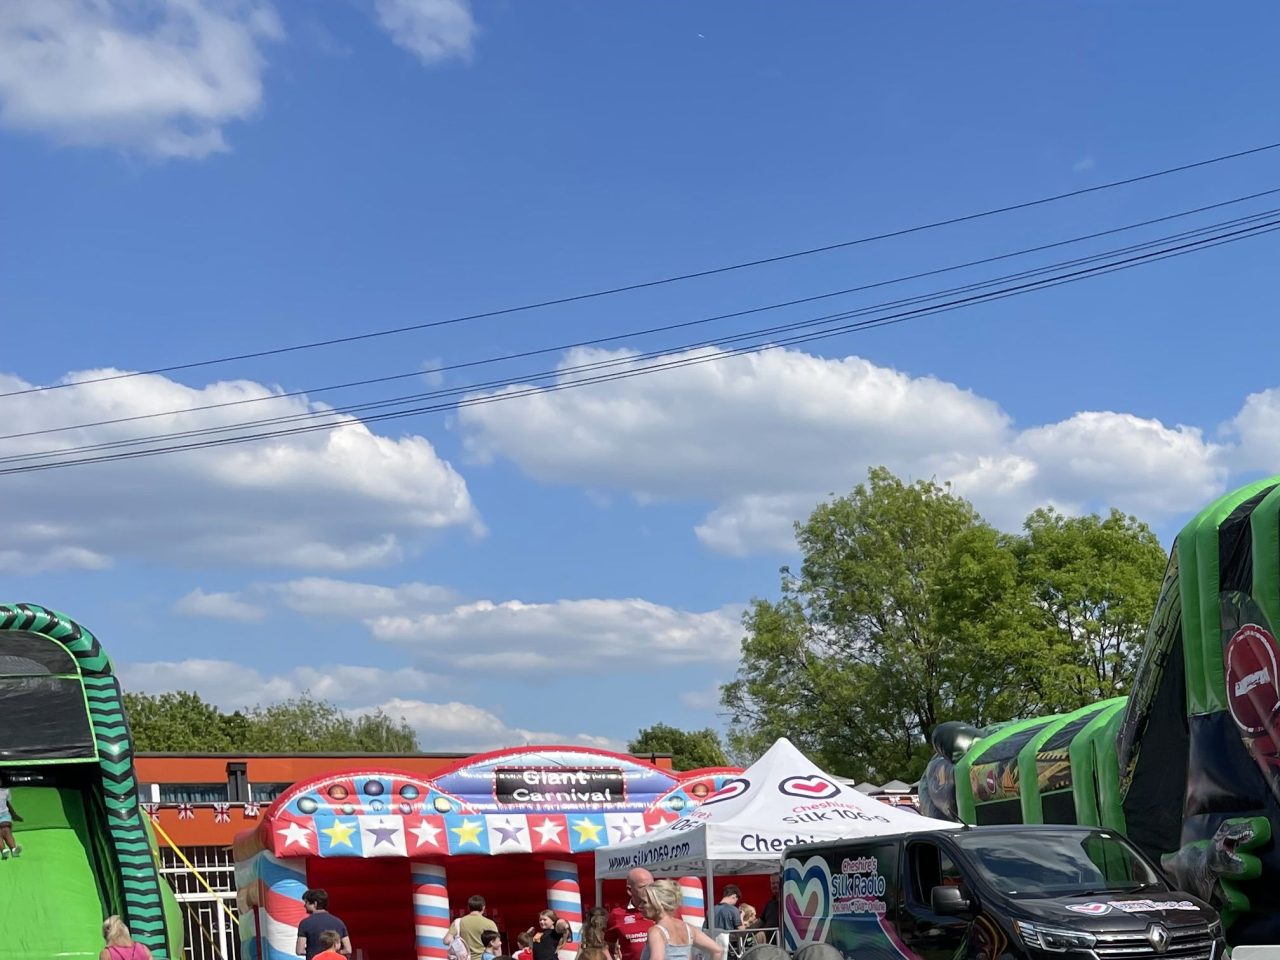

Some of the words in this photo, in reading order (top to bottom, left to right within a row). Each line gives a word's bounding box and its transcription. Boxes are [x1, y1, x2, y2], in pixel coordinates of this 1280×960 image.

[523, 769, 588, 785] Giant
[512, 788, 612, 801] Carnival
[842, 857, 877, 873] Cheshire's
[831, 874, 853, 898] Silk
[853, 872, 886, 897] Radio
